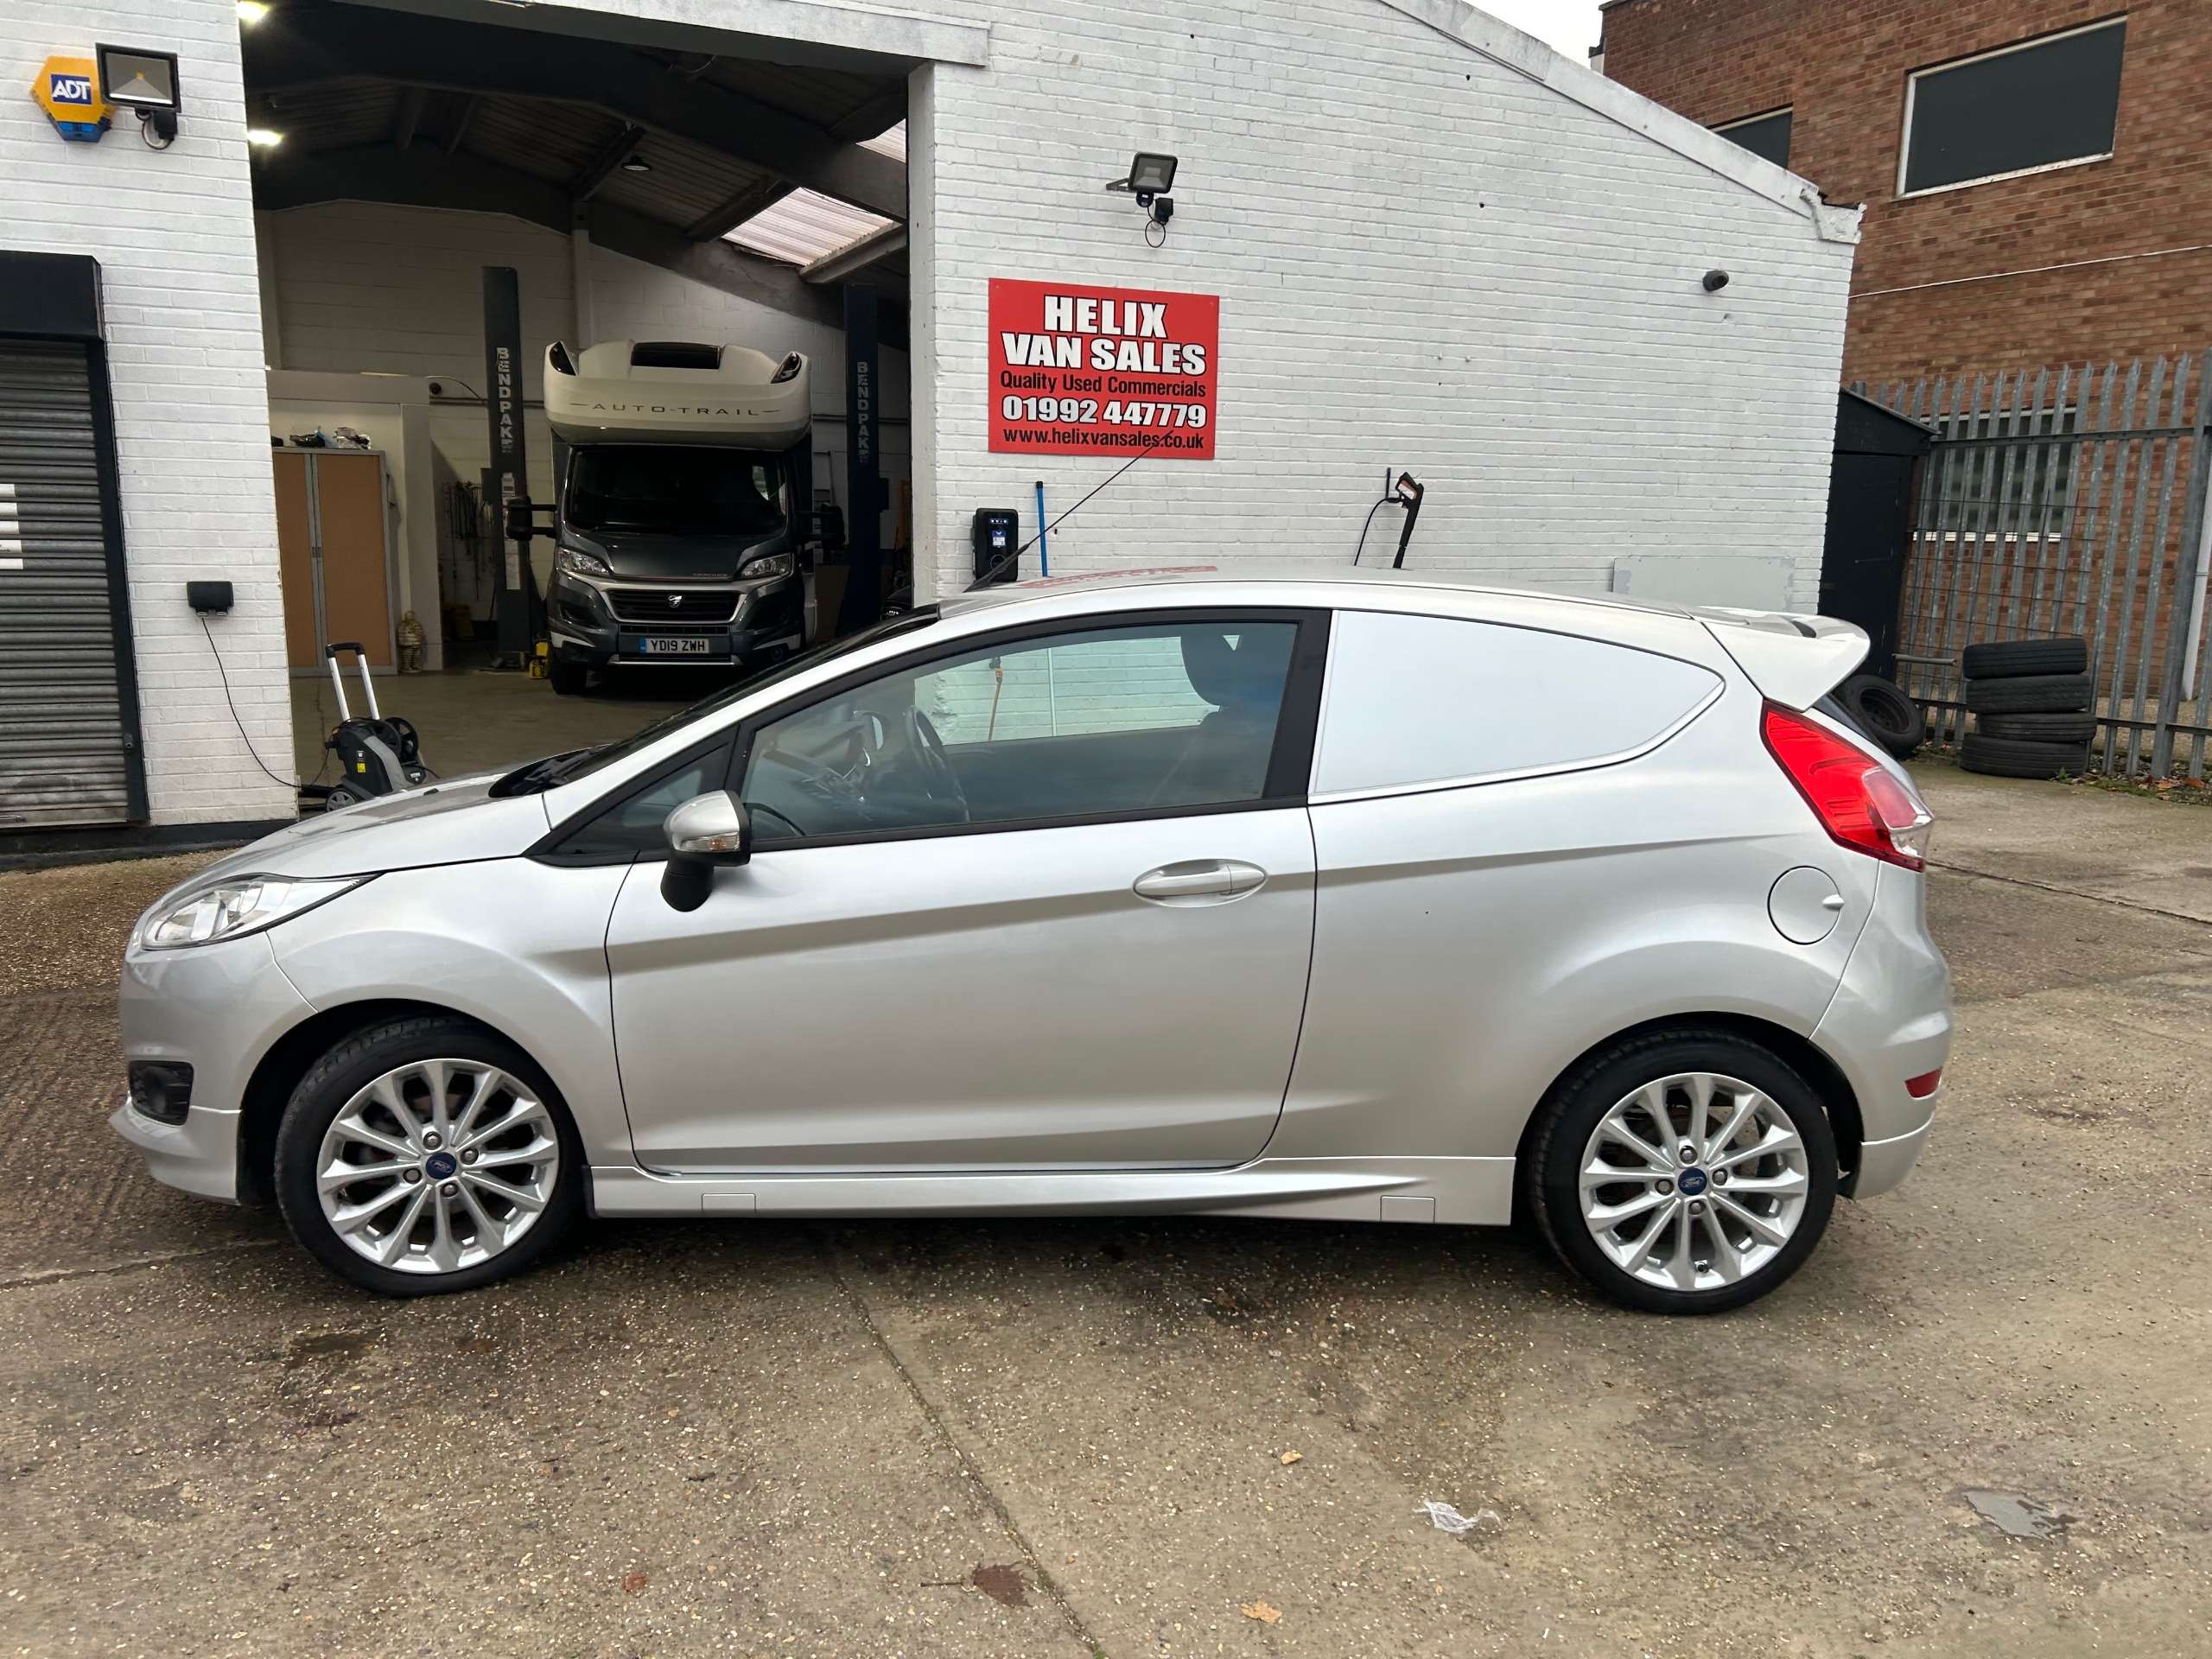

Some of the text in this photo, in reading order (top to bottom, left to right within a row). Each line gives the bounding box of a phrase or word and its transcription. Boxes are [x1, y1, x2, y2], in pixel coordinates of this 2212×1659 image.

[52, 79, 91, 100] ADT
[1044, 294, 1168, 340] HELIX
[1001, 332, 1207, 376] VAN SALES
[1001, 370, 1206, 397] Quality Used Commercials
[592, 403, 760, 416] AUTO-TRAIL
[1001, 394, 1207, 429] 01992 447779
[1003, 428, 1204, 449] www.helixvansales.co.uk
[651, 640, 678, 652] YD19
[682, 640, 705, 652] ZWH
